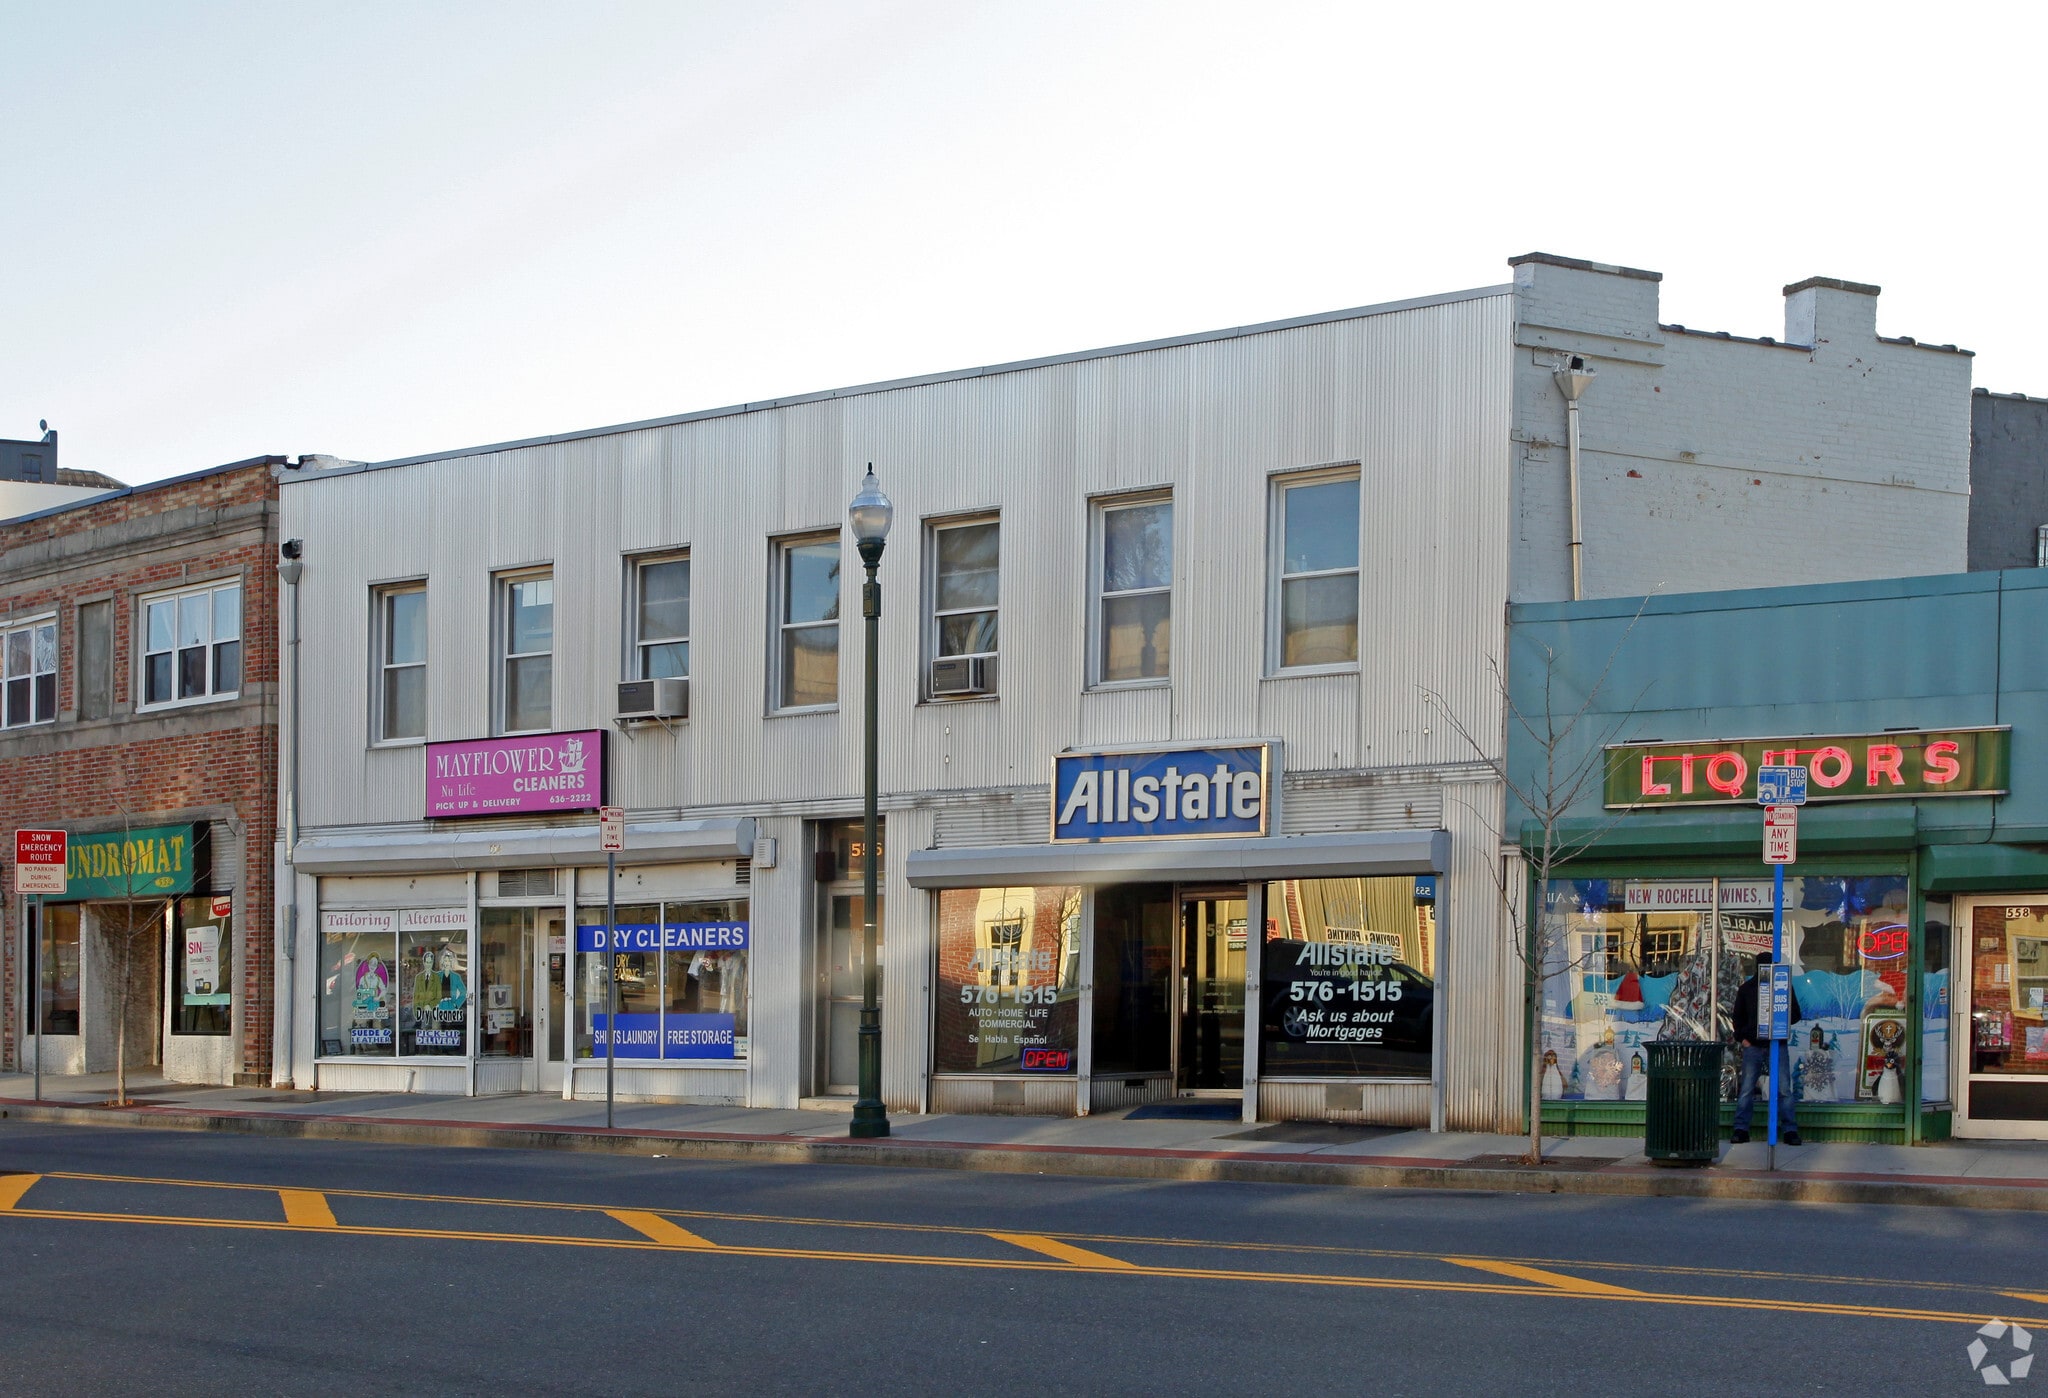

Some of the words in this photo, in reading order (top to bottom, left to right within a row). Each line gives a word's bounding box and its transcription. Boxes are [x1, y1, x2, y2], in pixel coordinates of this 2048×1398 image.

[436, 747, 554, 779] MAYFLOWER
[1790, 768, 1805, 779] BUS
[513, 774, 585, 793] CLEANERS
[1790, 779, 1805, 787] STOP
[441, 785, 453, 798] Nu
[458, 782, 476, 796] Life
[1057, 763, 1261, 825] Allstate
[436, 801, 454, 811] PICK
[458, 800, 469, 809] UP
[472, 800, 478, 809] &
[483, 798, 521, 808] DELIVERY
[550, 793, 591, 804] 636-2222
[1766, 810, 1773, 822] NO
[1774, 812, 1794, 820] STANDING
[31, 833, 52, 842] SNOW
[1771, 828, 1788, 839] ANY
[20, 843, 63, 852] EMERGENCY
[1770, 841, 1789, 852] TIME
[30, 853, 53, 862] ROUTE
[66, 834, 184, 880] UNDROMAT
[1628, 888, 1653, 904] NEW
[1657, 887, 1713, 904] ROCHELLE
[1720, 887, 1762, 906] WINES,
[405, 911, 466, 926] Alteration
[2007, 908, 2030, 918] 558
[327, 913, 391, 931] Tailoring
[594, 930, 632, 948] DRY
[636, 926, 744, 947] CLEANERS
[188, 942, 202, 955] SIN
[1295, 941, 1394, 966] Allstate
[967, 947, 1051, 971] Allstate
[1310, 968, 1331, 977] You're
[1332, 968, 1339, 976] in
[1340, 968, 1358, 978] good
[960, 984, 1058, 1004] 576-1515
[1289, 980, 1402, 1002] 576-1515
[1774, 994, 1787, 1003] BUS
[968, 1008, 992, 1018] AUTO
[998, 1009, 1023, 1018] HOME
[1029, 1009, 1048, 1018] LIFE
[1773, 1004, 1788, 1012] STOP
[416, 1006, 430, 1025] Dry
[432, 1006, 464, 1021] Cleaners
[1296, 1008, 1326, 1023] Ask
[1329, 1012, 1347, 1023] us
[1351, 1008, 1395, 1023] about
[978, 1019, 1037, 1029] COMMERCIAL
[351, 1029, 380, 1037] SUEDE
[416, 1030, 461, 1038] PICK-UP
[594, 1029, 621, 1045] SHITS
[622, 1029, 658, 1045] LAUNDRY
[667, 1029, 689, 1045] FREE
[691, 1029, 732, 1045] STORAGE
[1306, 1023, 1384, 1041] Mortgages
[351, 1036, 391, 1044] LEATHER
[416, 1037, 461, 1046] DELIVERY
[968, 1034, 979, 1044] Se
[985, 1034, 1008, 1044] Habla
[1013, 1034, 1047, 1046] Español
[1025, 1050, 1069, 1068] OPEN
